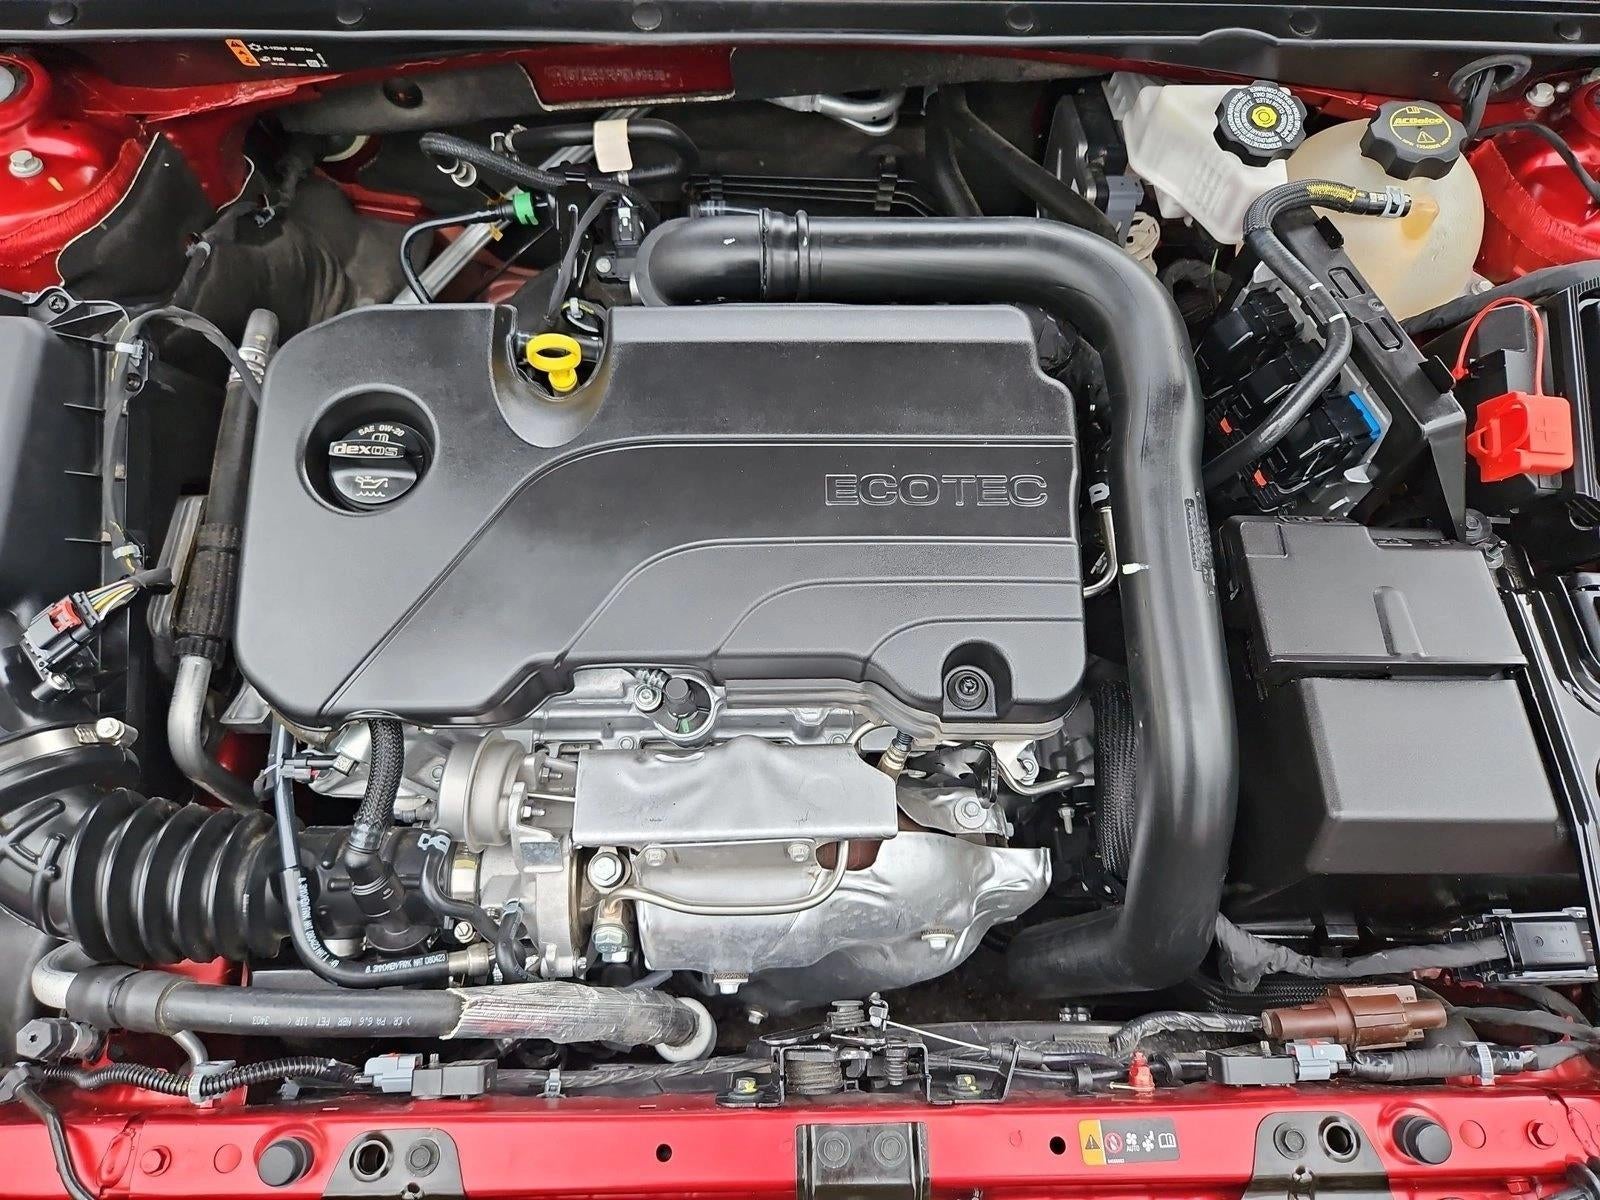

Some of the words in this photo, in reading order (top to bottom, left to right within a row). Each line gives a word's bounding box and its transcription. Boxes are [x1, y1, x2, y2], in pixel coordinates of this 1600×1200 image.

[1393, 117, 1442, 126] ACDelco
[358, 426, 376, 436] SAE
[379, 424, 405, 437] 0W-20
[334, 443, 398, 456] dexos
[825, 474, 1048, 508] ECOTEC
[316, 1016, 330, 1026] PET
